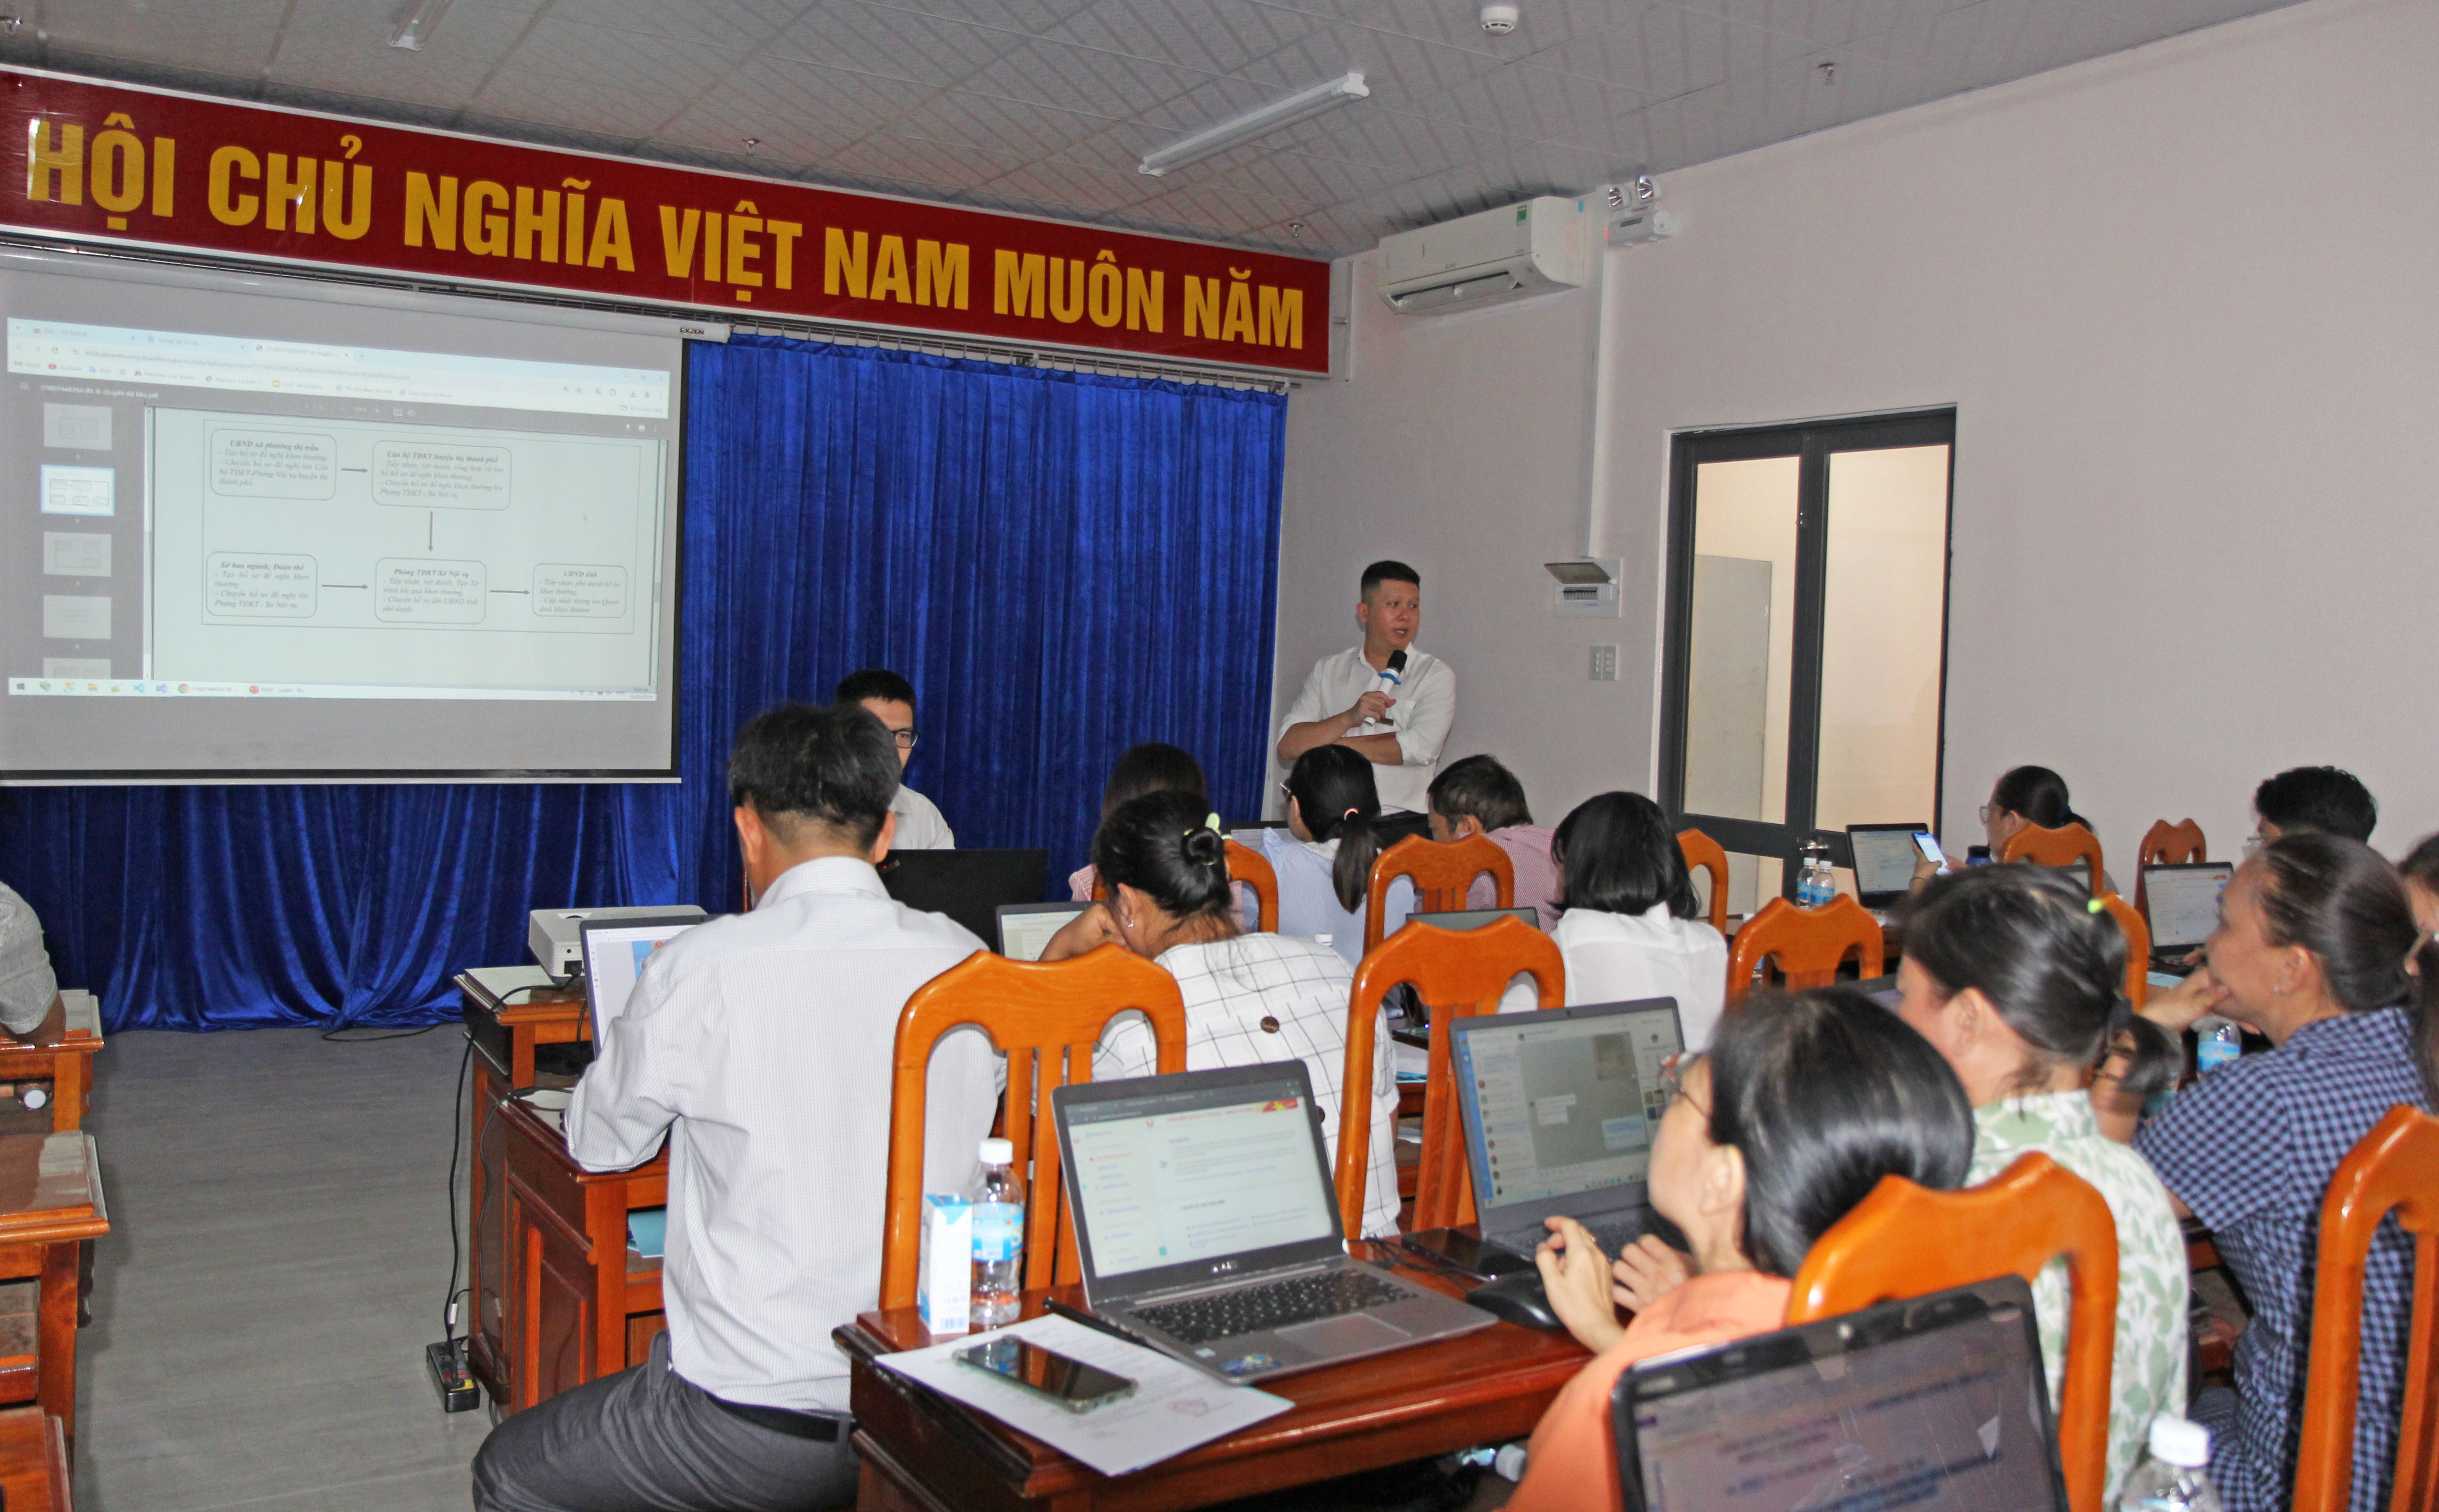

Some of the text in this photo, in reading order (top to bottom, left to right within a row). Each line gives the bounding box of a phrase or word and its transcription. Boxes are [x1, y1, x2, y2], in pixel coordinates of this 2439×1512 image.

[27, 113, 1302, 348] HỘI CHỦ NGHĨA VIỆT NAM MUÔN NĂM
